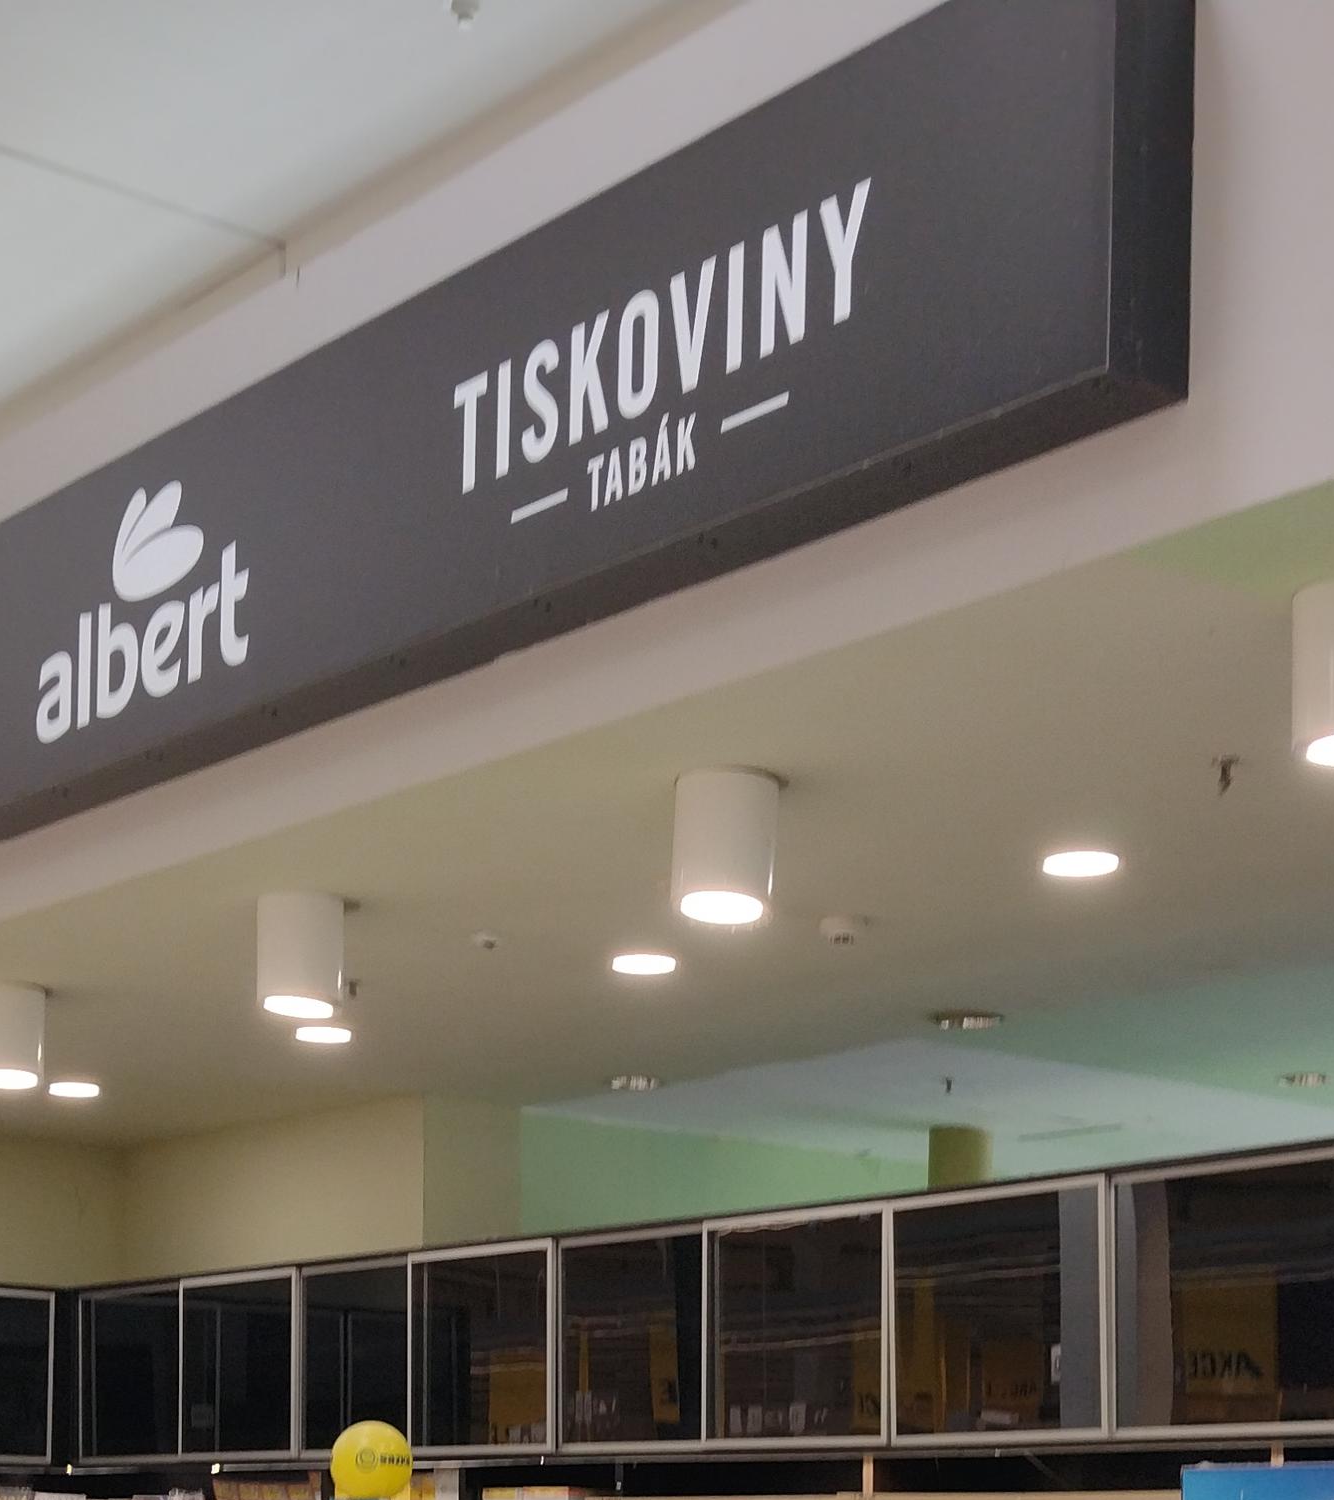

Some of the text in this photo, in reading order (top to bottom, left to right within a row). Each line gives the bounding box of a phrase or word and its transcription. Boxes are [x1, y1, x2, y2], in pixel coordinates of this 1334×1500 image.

[453, 177, 871, 494] TISKOVINY
[587, 413, 696, 512] TABÁK
[36, 540, 249, 744] albert
